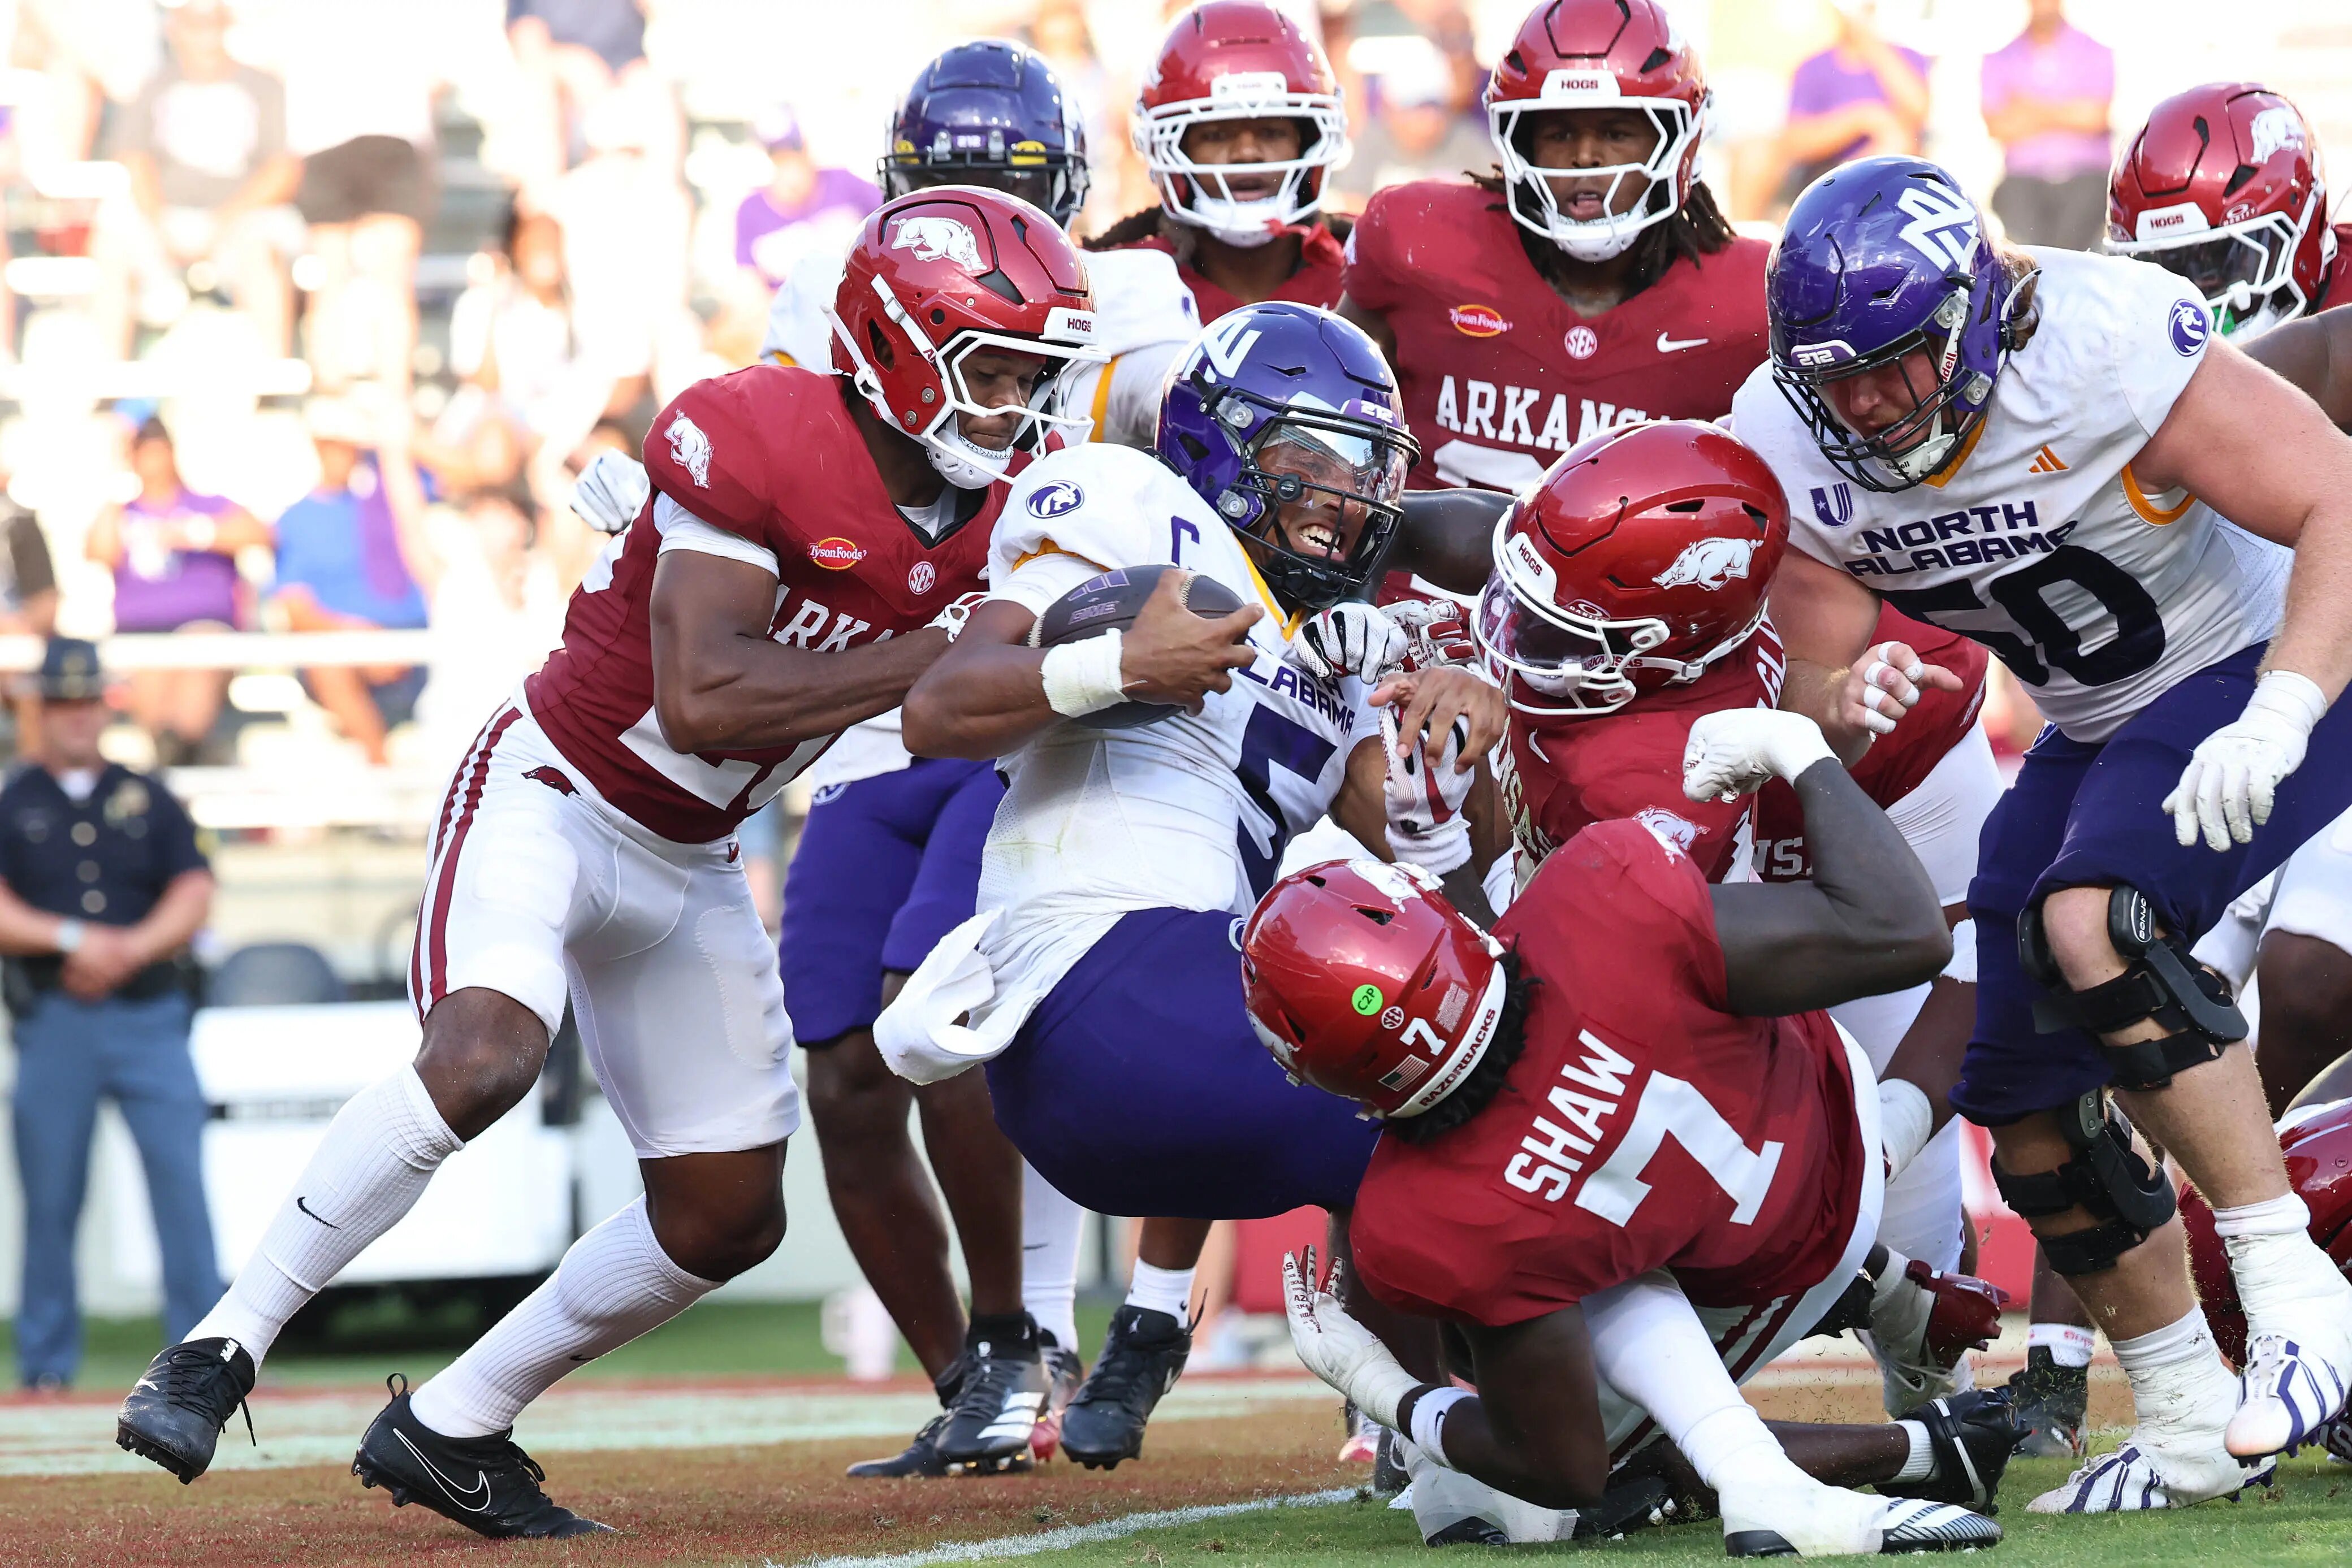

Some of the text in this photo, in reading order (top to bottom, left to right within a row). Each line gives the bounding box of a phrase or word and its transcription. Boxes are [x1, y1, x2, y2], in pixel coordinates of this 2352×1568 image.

[1561, 80, 1598, 89] HOGS
[2150, 214, 2184, 229] HOGS
[1067, 317, 1091, 332] HOGS
[1566, 327, 1596, 358] SEC
[1797, 349, 1836, 366] 212
[1360, 399, 1394, 424] 212
[1861, 500, 2039, 553] NORTH
[1519, 543, 1543, 577] HOGS
[1844, 520, 2073, 577] ALABAMA
[910, 562, 934, 592] SEC
[1870, 544, 2166, 687] 50
[1357, 987, 1376, 1011] C2P
[1382, 1007, 1403, 1029] SEC
[1399, 1017, 1447, 1056] 7
[1419, 1008, 1496, 1106] RAZORBACKS
[1504, 1028, 1635, 1202] SHAW
[1574, 1069, 1784, 1228] 7
